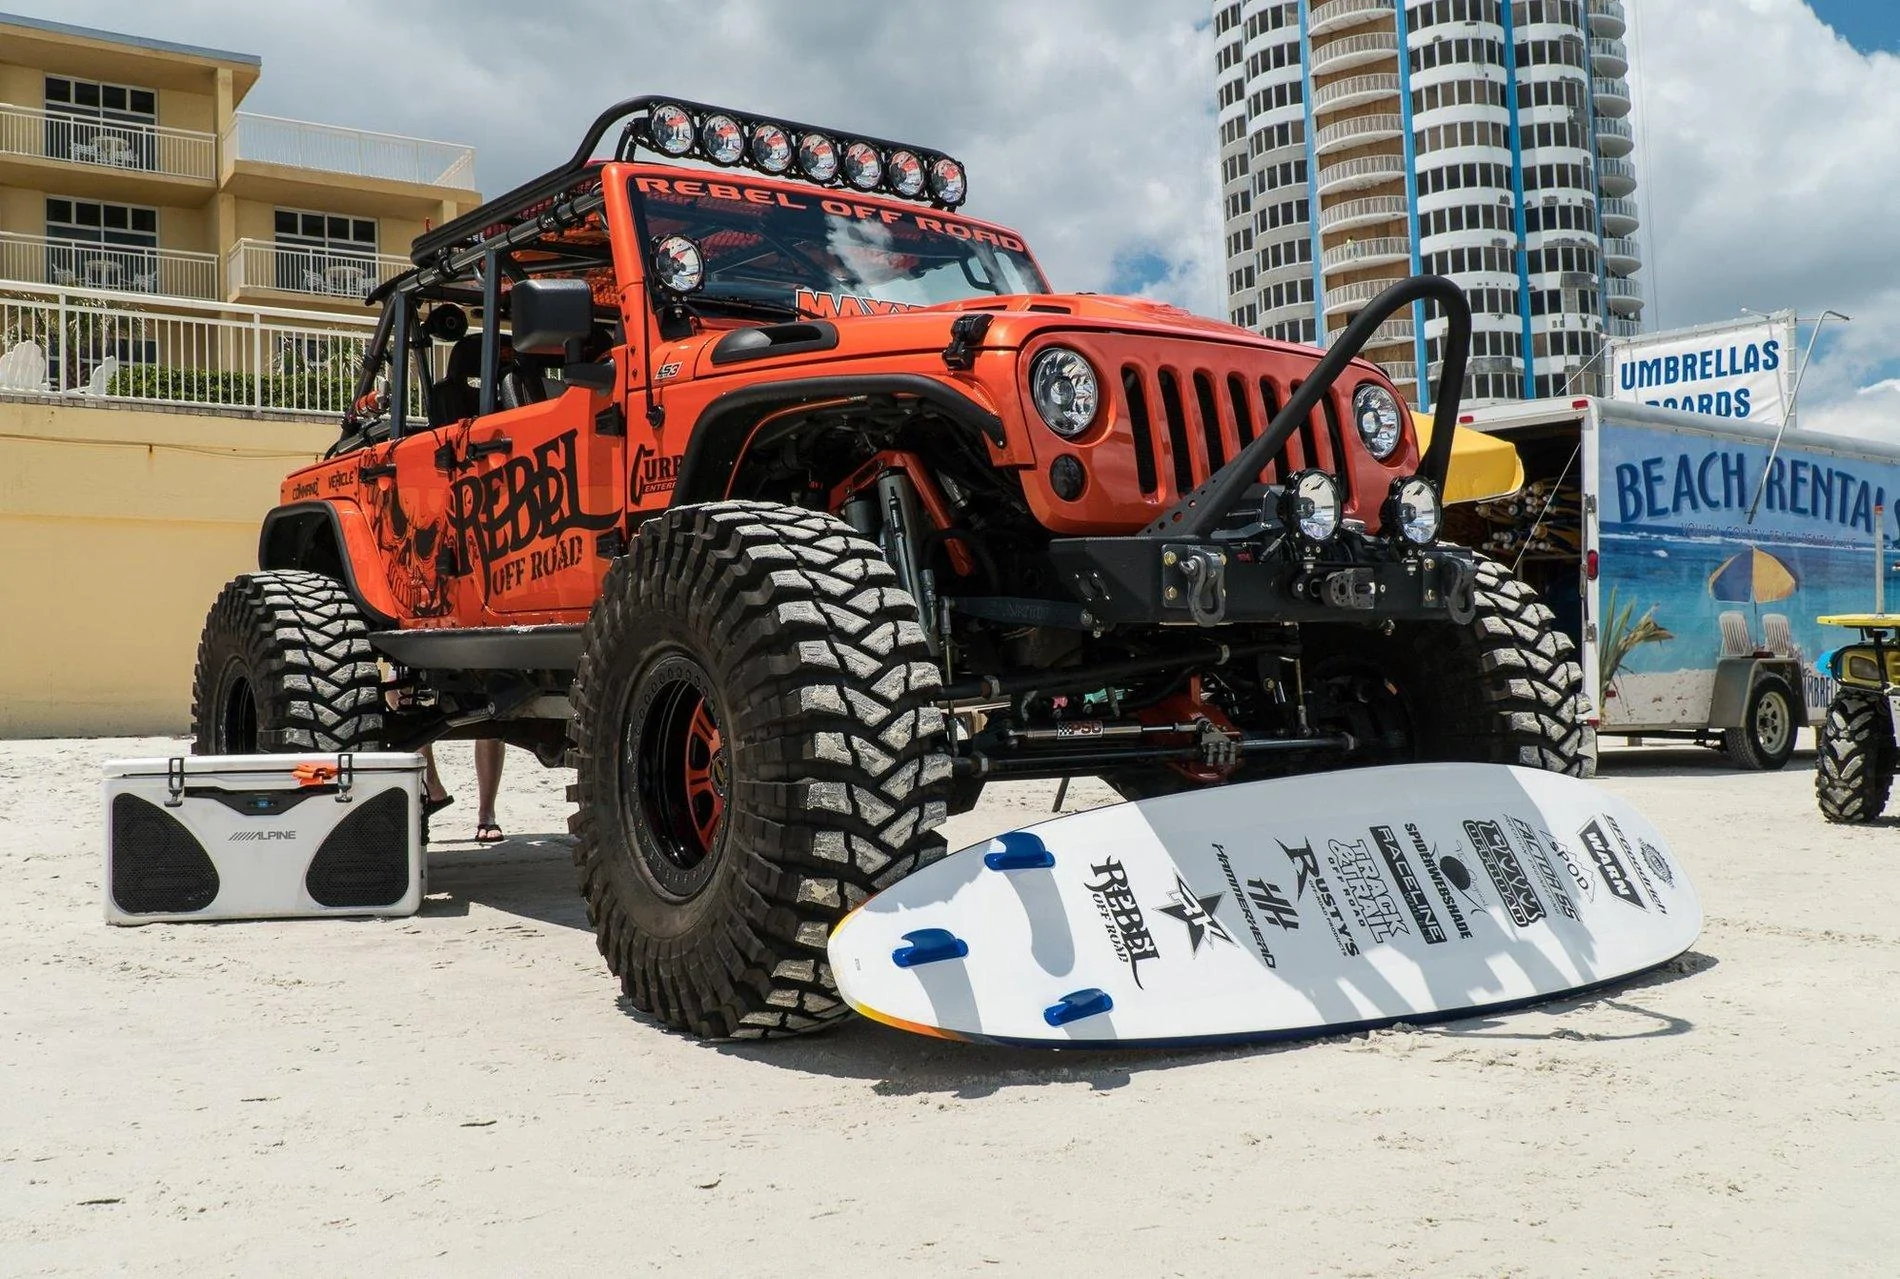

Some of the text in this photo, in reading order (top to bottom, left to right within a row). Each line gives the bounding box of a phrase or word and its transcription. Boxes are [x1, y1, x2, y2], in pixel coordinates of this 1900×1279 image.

[636, 177, 1024, 252] REBEL OFF ROAD
[796, 289, 926, 321] MAX
[1620, 340, 1780, 391] UMBRELLAS
[328, 470, 355, 490] VEHICLE
[1615, 451, 1900, 549] BEACH RENTAL
[445, 428, 624, 609] REBEL
[492, 535, 583, 596] OFF ROAD
[248, 830, 297, 841] ALPINE
[1512, 817, 1563, 891] FACTOR
[1586, 831, 1631, 895] WARN
[1605, 814, 1668, 915] BFGoodrich
[1274, 836, 1361, 957] RUSTY'S
[1328, 857, 1366, 928] OFF ROAD
[1350, 839, 1411, 938] TRACK
[1377, 827, 1447, 942] RACELINE
[1404, 822, 1473, 940] SPIDERWEBSHADE
[1464, 822, 1527, 926] OFFROAD
[1083, 855, 1160, 990] REBEL
[1092, 893, 1129, 963] OFF ROAD
[1326, 916, 1348, 957] PRODUCTS
